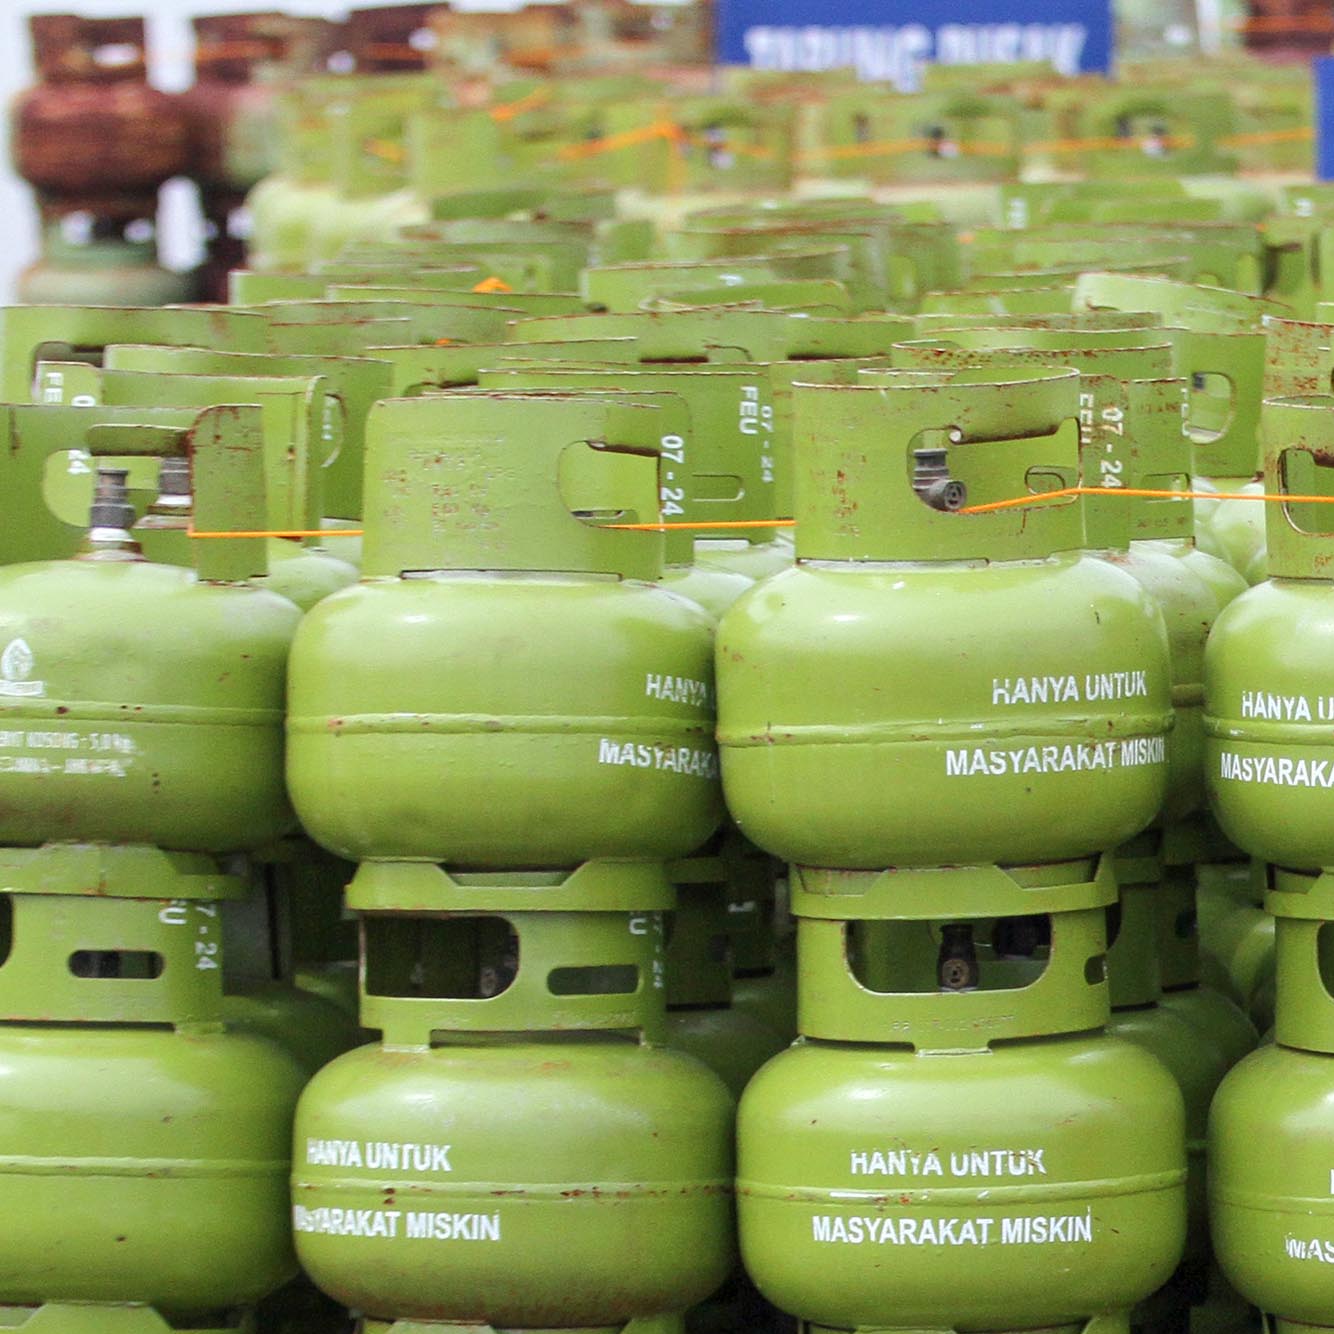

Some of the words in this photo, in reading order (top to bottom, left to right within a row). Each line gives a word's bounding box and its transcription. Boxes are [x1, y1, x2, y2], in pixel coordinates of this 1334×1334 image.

[44, 371, 64, 402] FE
[739, 385, 759, 435] FEU
[992, 675, 1080, 705] HANYA
[1085, 670, 1147, 701] UNTUK
[1241, 691, 1312, 722] HANYA
[598, 738, 716, 778] MASYARAK
[945, 741, 1116, 776] MASYARAKAT
[1120, 737, 1164, 767] MISKIN
[307, 1139, 363, 1168] HANYA
[365, 1142, 452, 1172] UNTUK
[850, 1149, 944, 1176] HANYA
[950, 1149, 1046, 1177] UNTUK
[406, 1211, 501, 1241] MISKIN
[812, 1215, 994, 1245] MASYARAKAT
[1001, 1214, 1093, 1245] MISKIN
